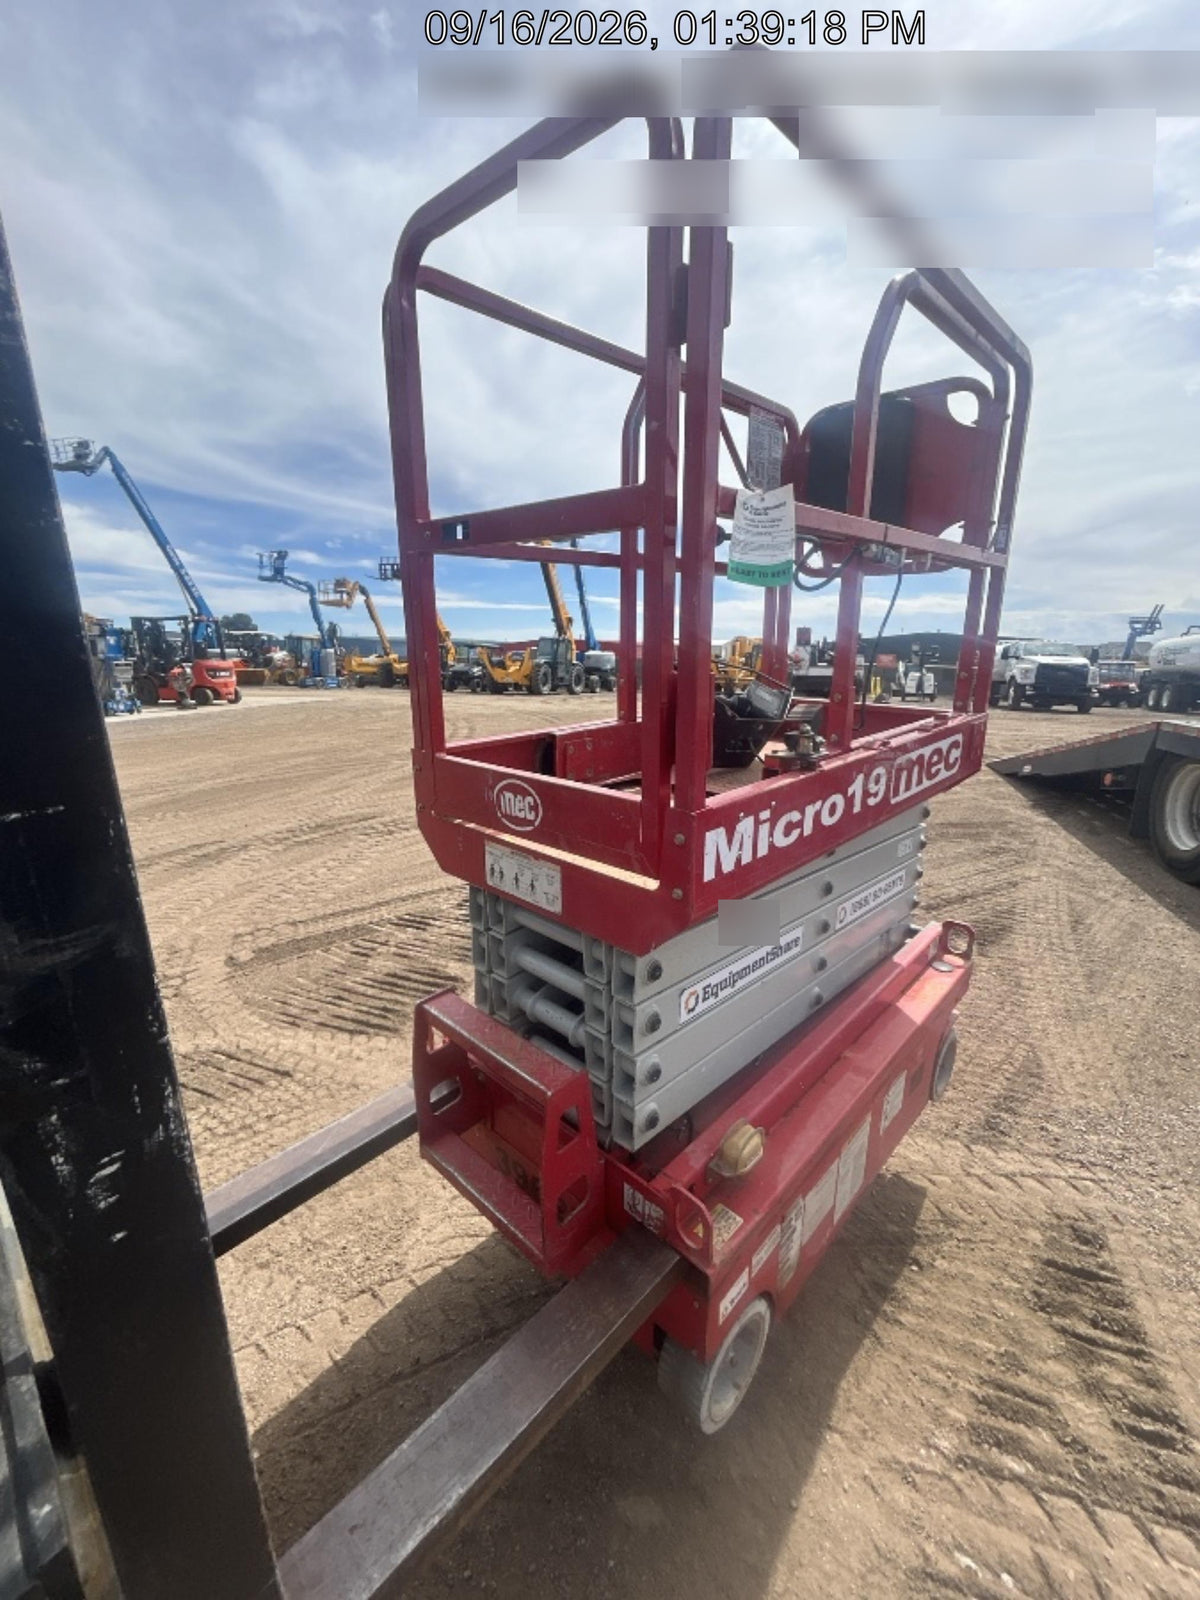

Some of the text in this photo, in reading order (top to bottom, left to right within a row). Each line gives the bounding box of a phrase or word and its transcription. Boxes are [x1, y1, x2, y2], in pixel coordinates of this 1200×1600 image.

[893, 738, 961, 800] mec
[501, 791, 536, 821] mec
[701, 936, 801, 1003] EquipmentShare
